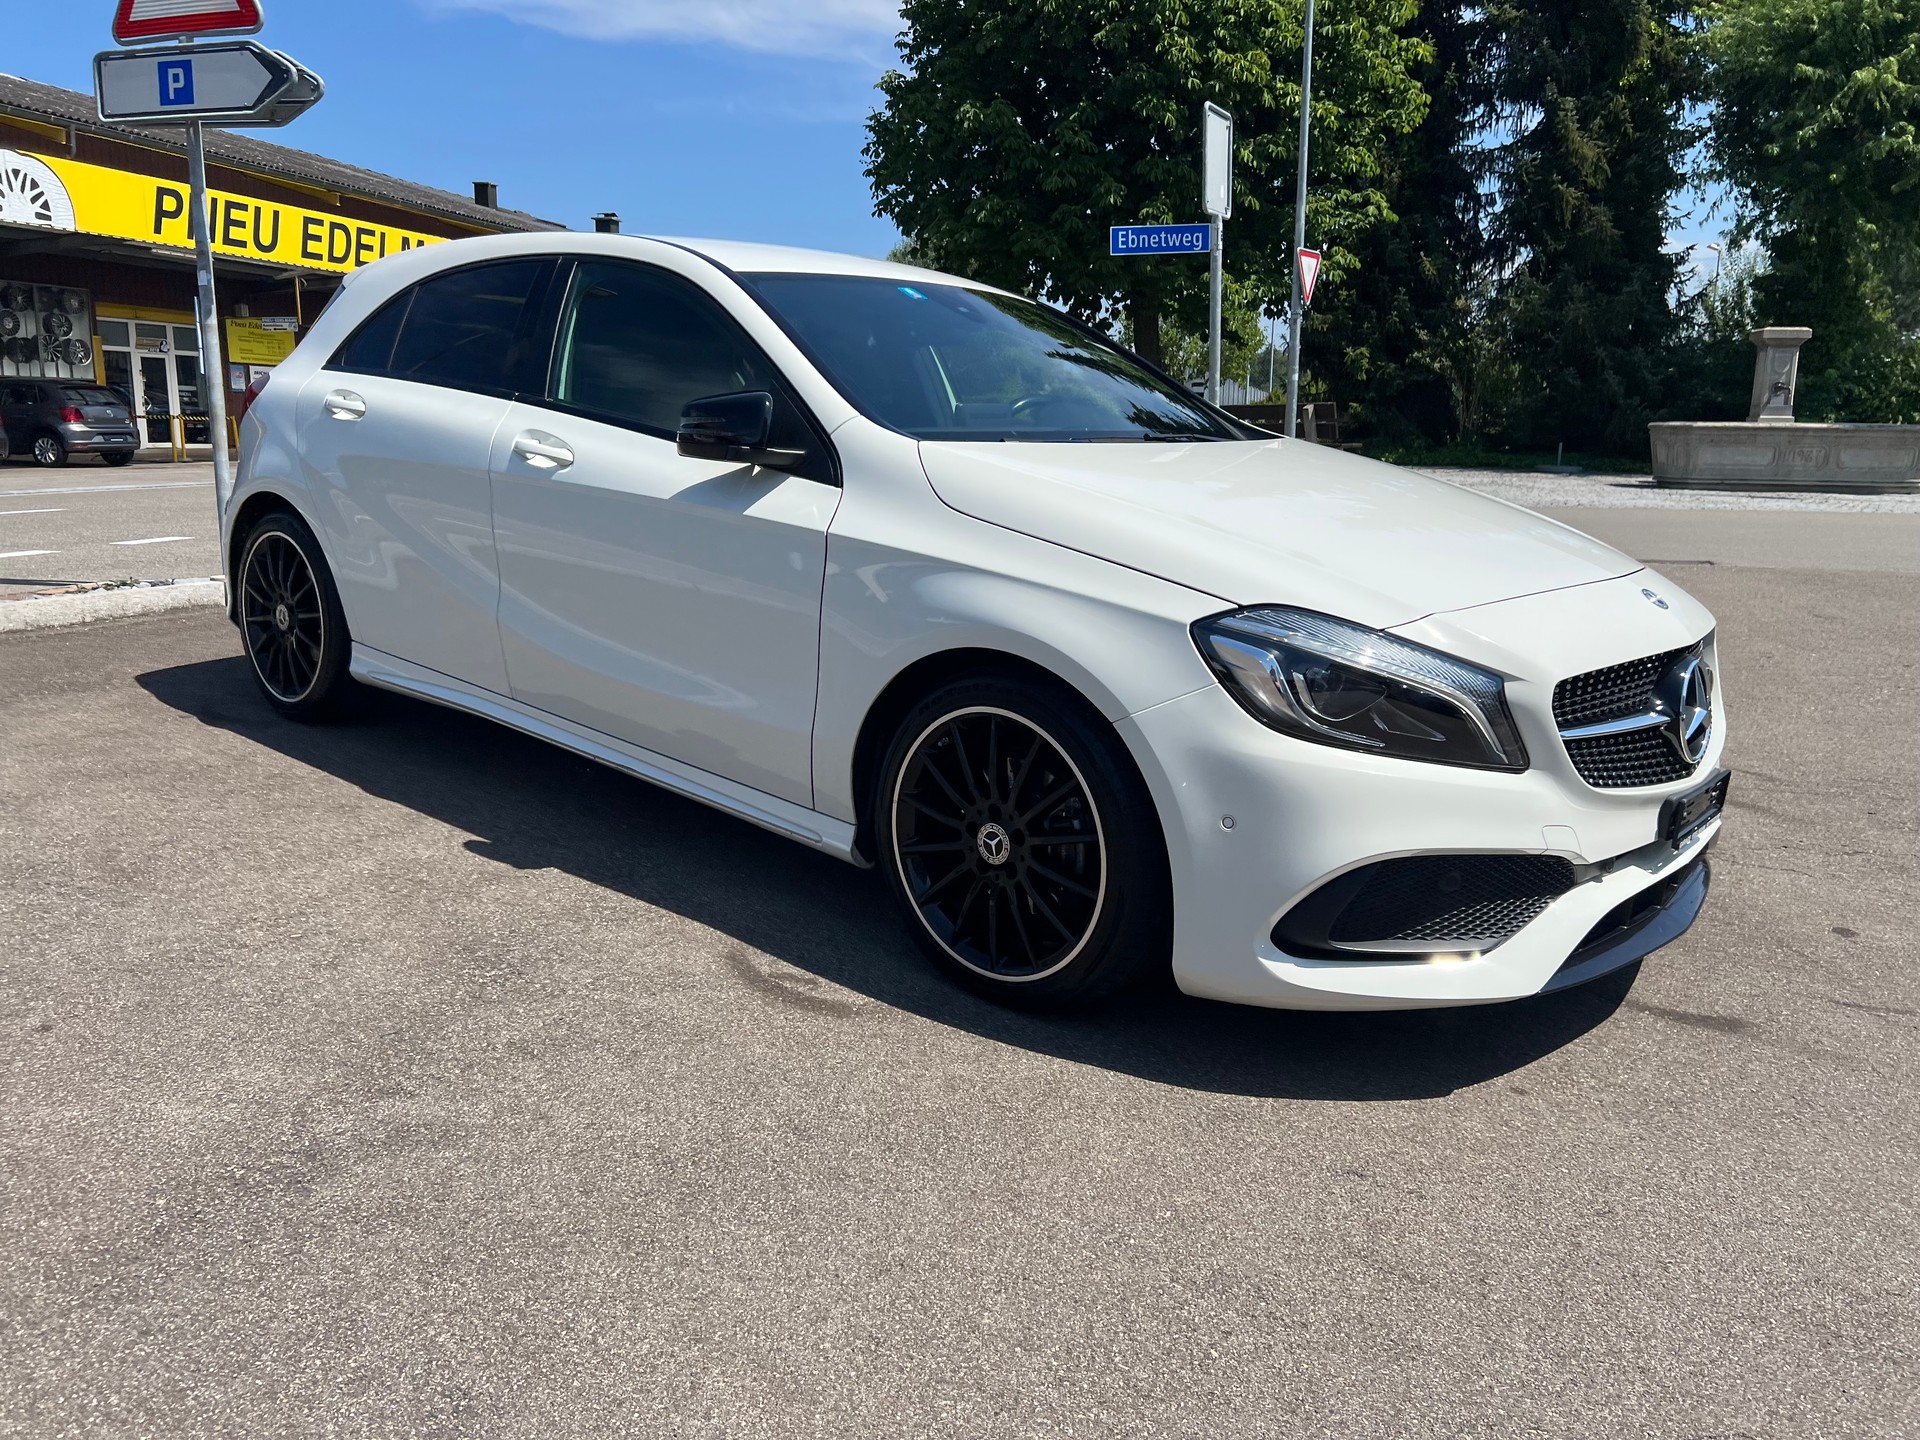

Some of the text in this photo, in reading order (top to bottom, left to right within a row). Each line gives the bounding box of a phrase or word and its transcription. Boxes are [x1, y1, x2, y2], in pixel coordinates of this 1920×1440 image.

[167, 67, 185, 100] P
[153, 185, 280, 253] PNEU
[1118, 229, 1203, 251] Ebnetweg
